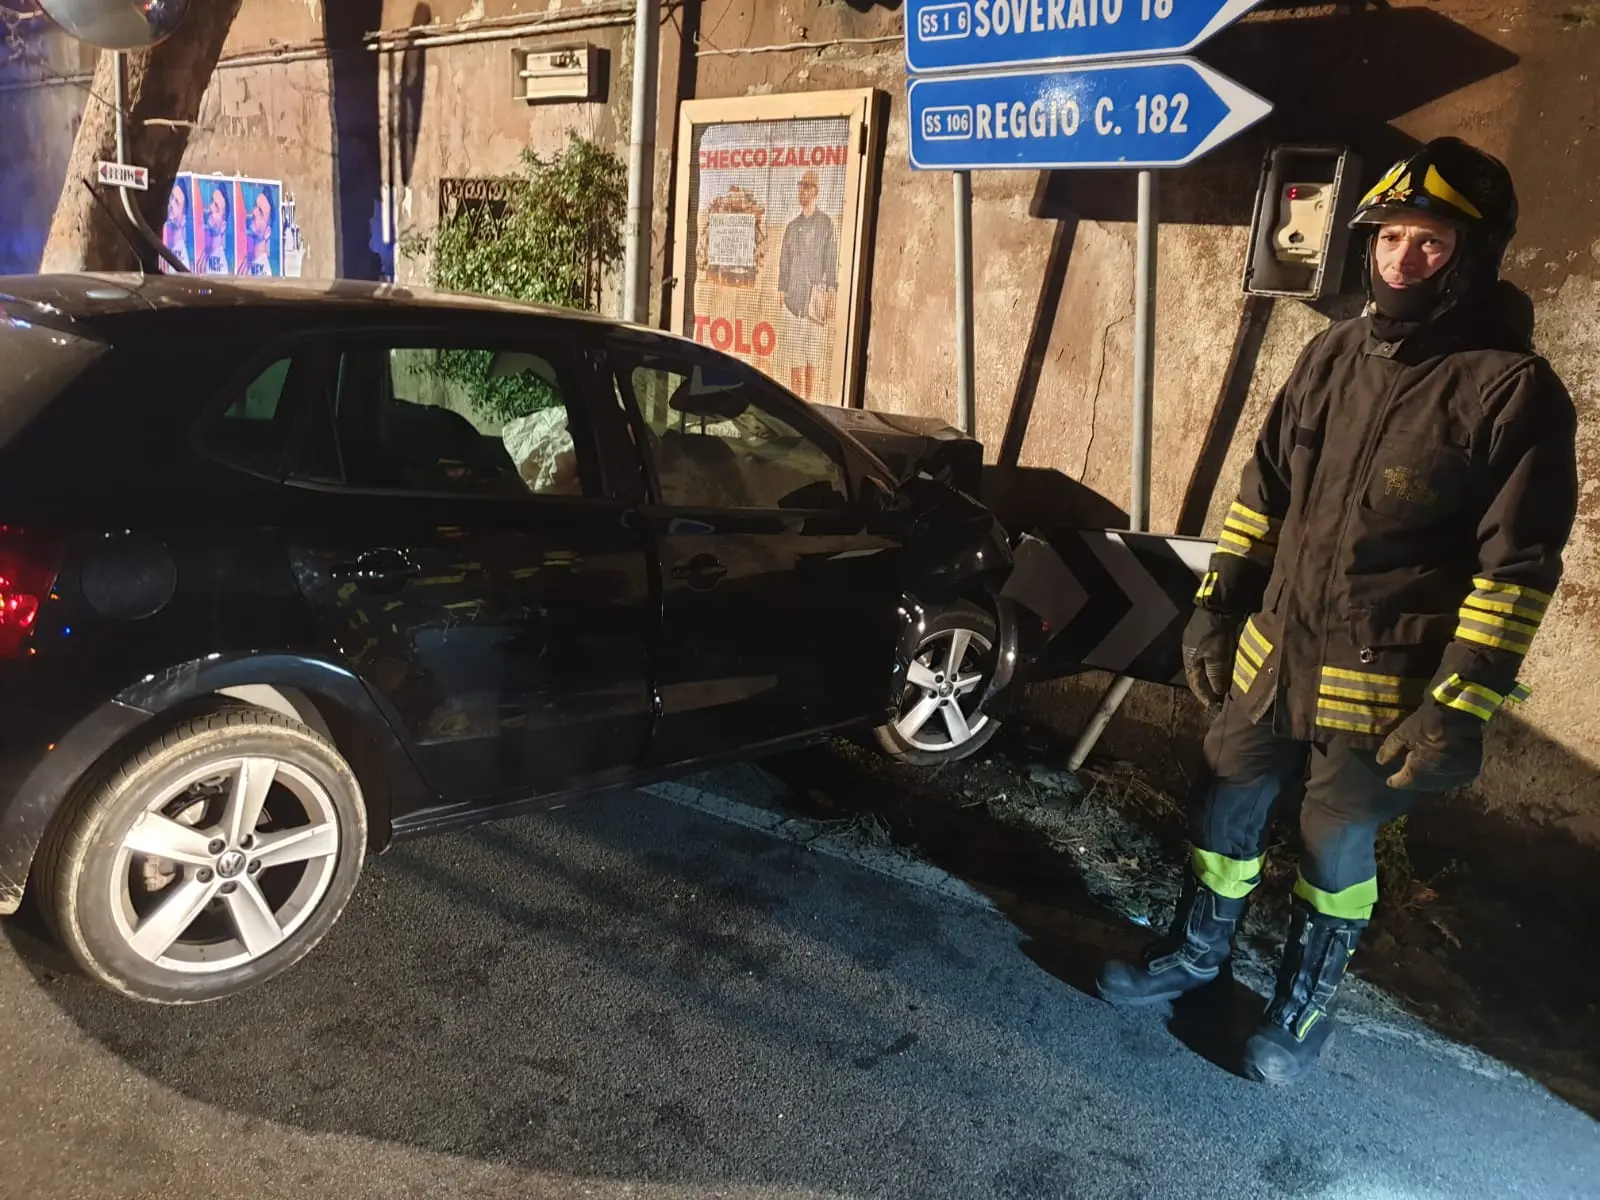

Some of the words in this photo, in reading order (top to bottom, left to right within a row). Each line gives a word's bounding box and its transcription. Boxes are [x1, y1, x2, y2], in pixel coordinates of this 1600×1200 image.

[922, 14, 938, 33] SS
[974, 0, 1123, 38] SOVERATO
[926, 114, 941, 133] SS
[946, 113, 969, 132] 106
[976, 100, 1080, 139] REGGIO
[1095, 96, 1122, 135] C.
[1135, 92, 1189, 134] 182
[700, 148, 767, 170] CHECCO
[771, 144, 848, 168] ZALONI
[695, 315, 776, 357] TOLO
